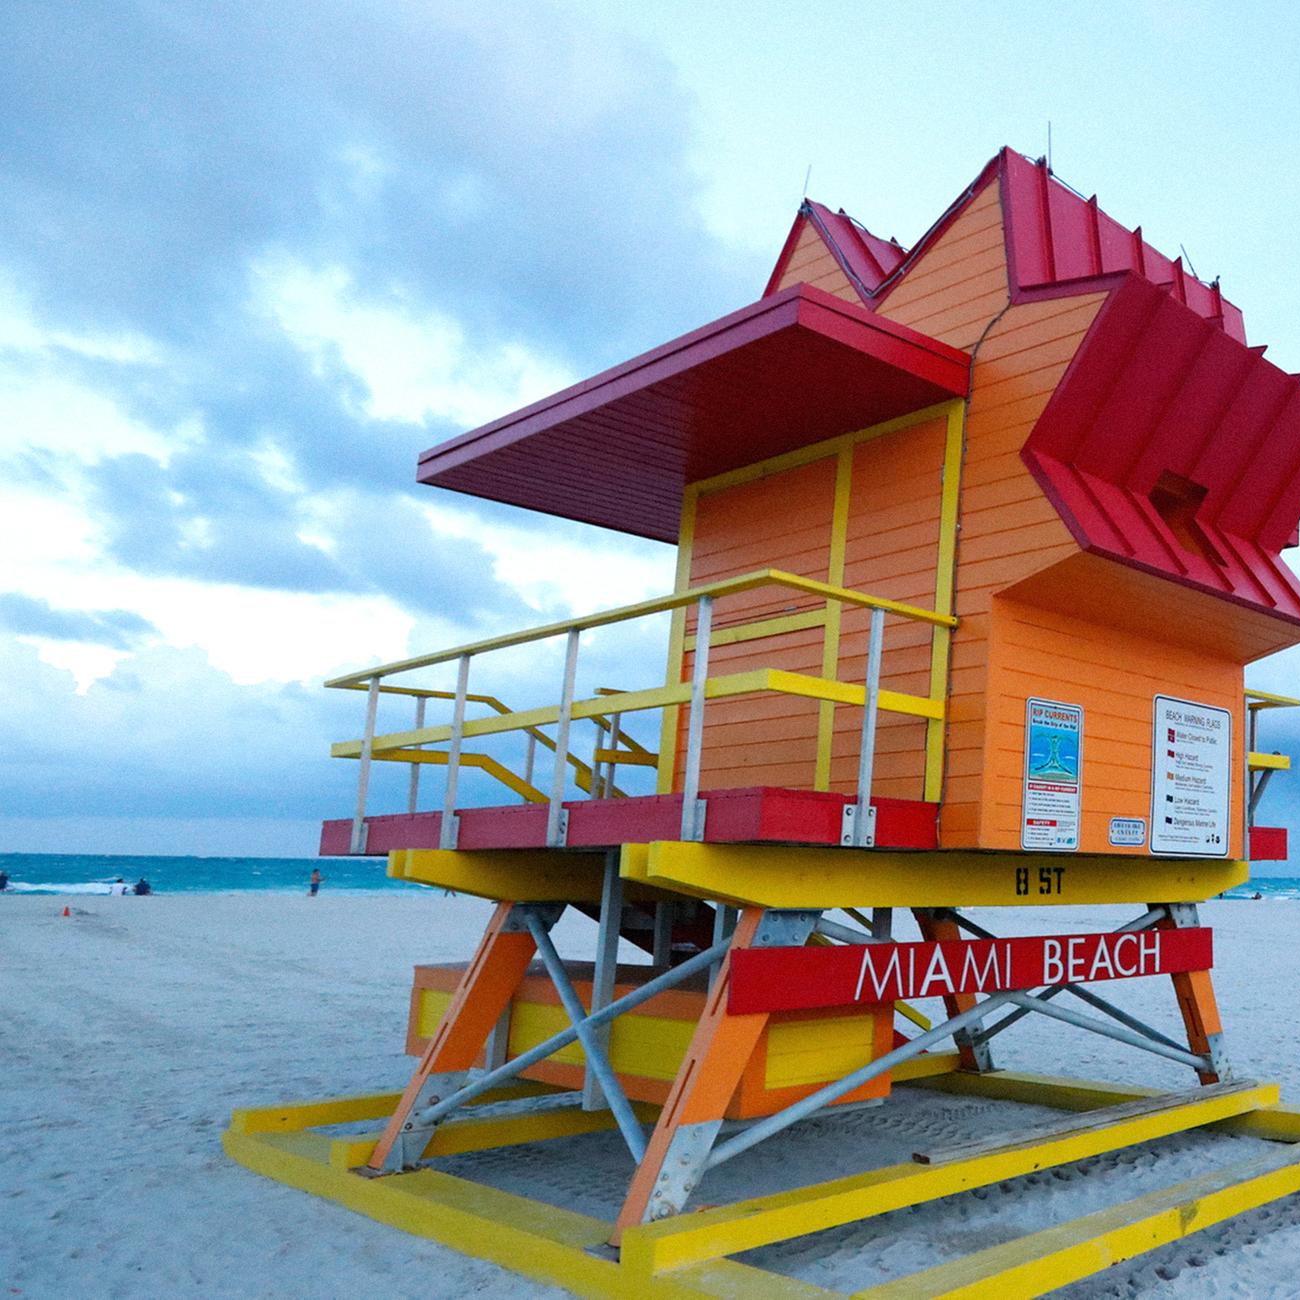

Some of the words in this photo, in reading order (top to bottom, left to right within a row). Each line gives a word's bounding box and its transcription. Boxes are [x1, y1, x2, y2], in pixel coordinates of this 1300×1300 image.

[1044, 710, 1078, 723] CURRENTS
[1166, 709, 1182, 721] BEACH
[1184, 714, 1205, 727] WARNING
[1176, 751, 1184, 760] High
[1185, 752, 1199, 761] Hazard
[1175, 773, 1191, 782] Medium
[1192, 775, 1207, 785] Hazard
[1174, 795, 1184, 804] Low
[1184, 797, 1200, 806] Hazard
[1174, 817, 1195, 827] Dangerous
[1195, 819, 1208, 828] Marine
[1015, 867, 1029, 896] 8
[1038, 867, 1066, 895] ST
[854, 943, 1012, 1001] MIAMI
[1043, 931, 1161, 985] BEACH
